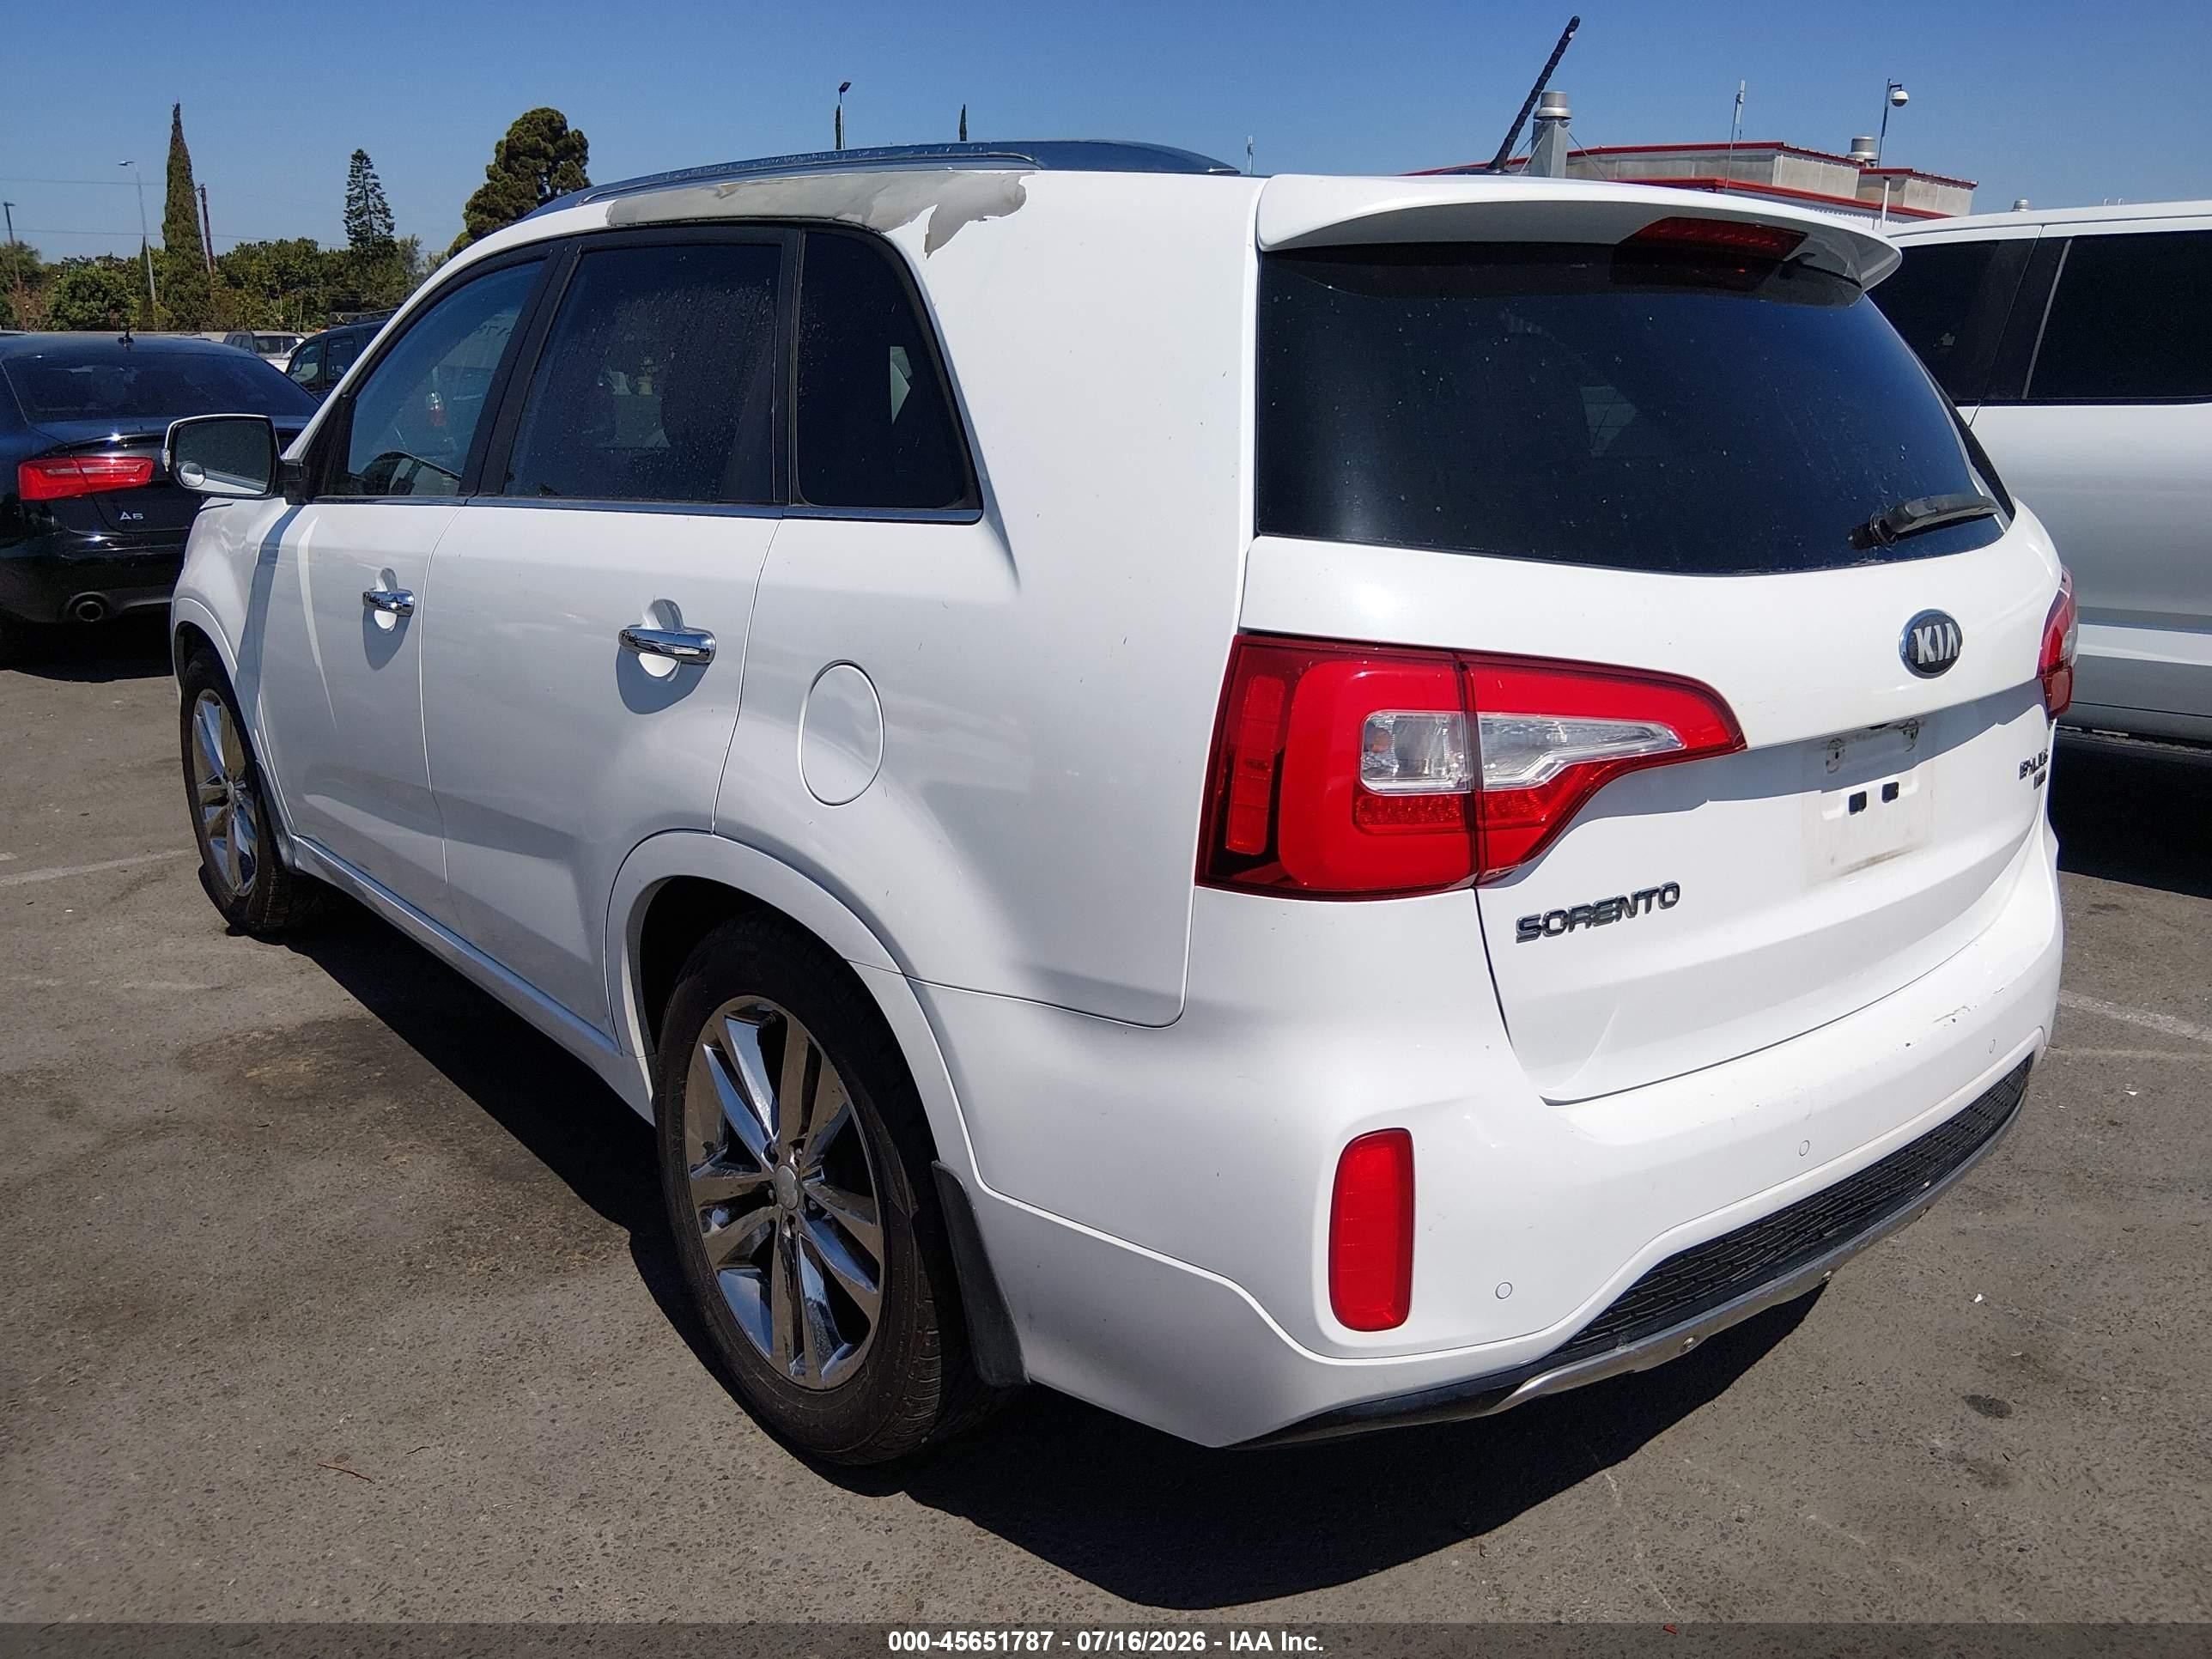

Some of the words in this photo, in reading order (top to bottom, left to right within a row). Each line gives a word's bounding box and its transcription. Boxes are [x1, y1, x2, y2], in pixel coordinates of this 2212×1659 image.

[119, 511, 144, 520] A6
[1913, 623, 1959, 664] KIA
[1516, 881, 1680, 944] SORENTO
